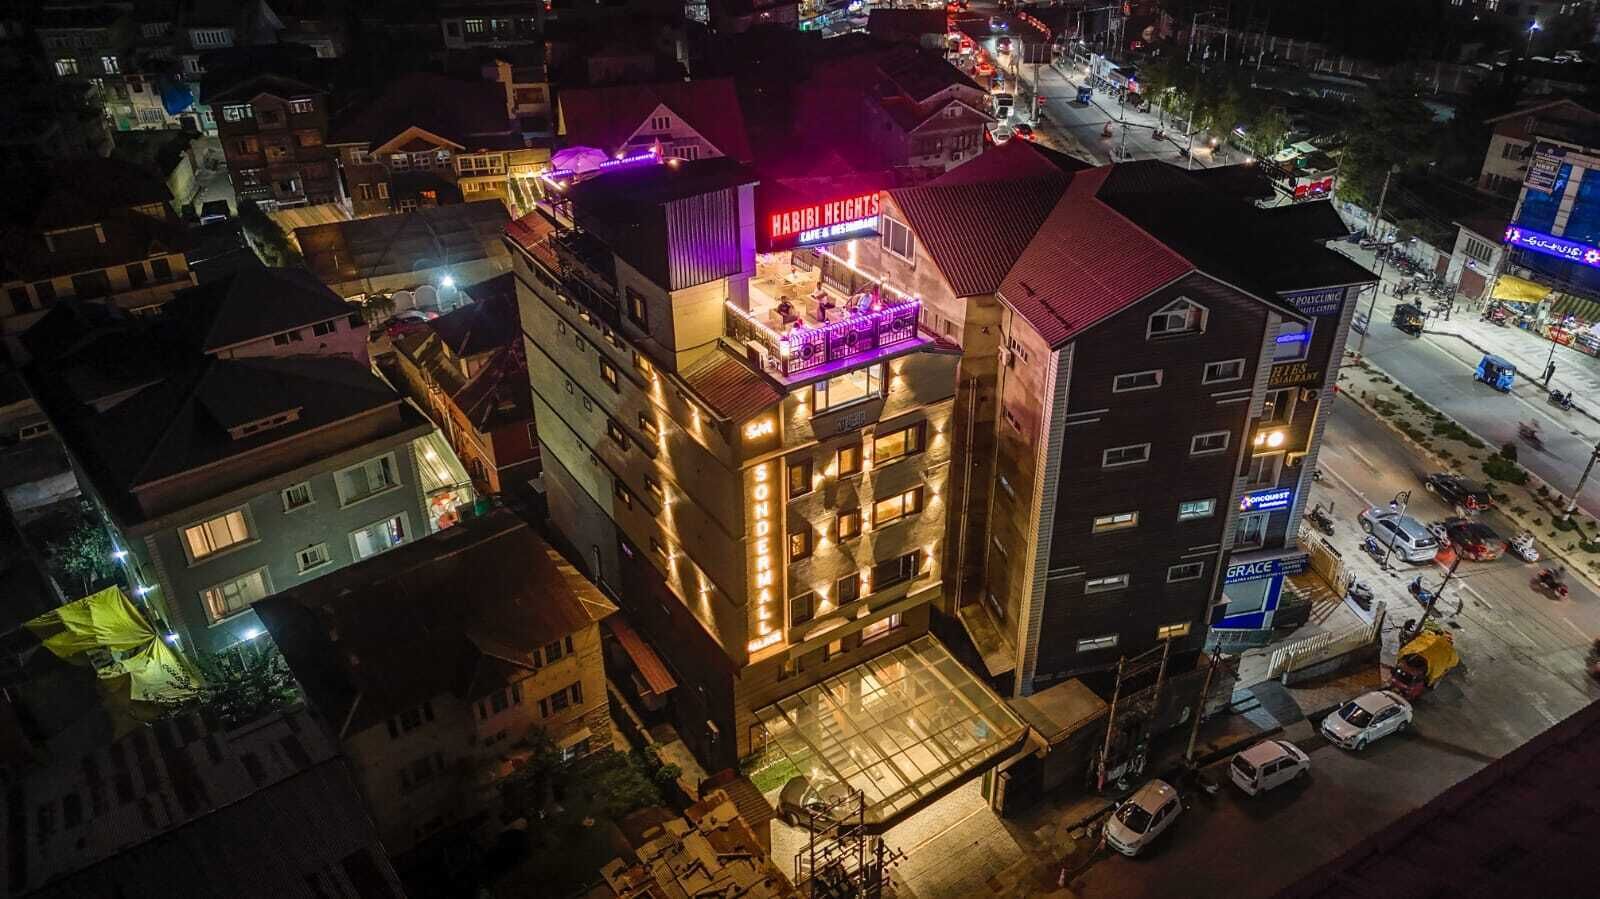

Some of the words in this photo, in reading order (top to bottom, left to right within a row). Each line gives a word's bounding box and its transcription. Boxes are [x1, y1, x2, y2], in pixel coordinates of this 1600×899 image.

[772, 206, 820, 237] HABIBI
[825, 193, 880, 225] HEIGHTS
[1296, 293, 1340, 306] POLYCLINIC
[1226, 560, 1273, 578] GRACE
